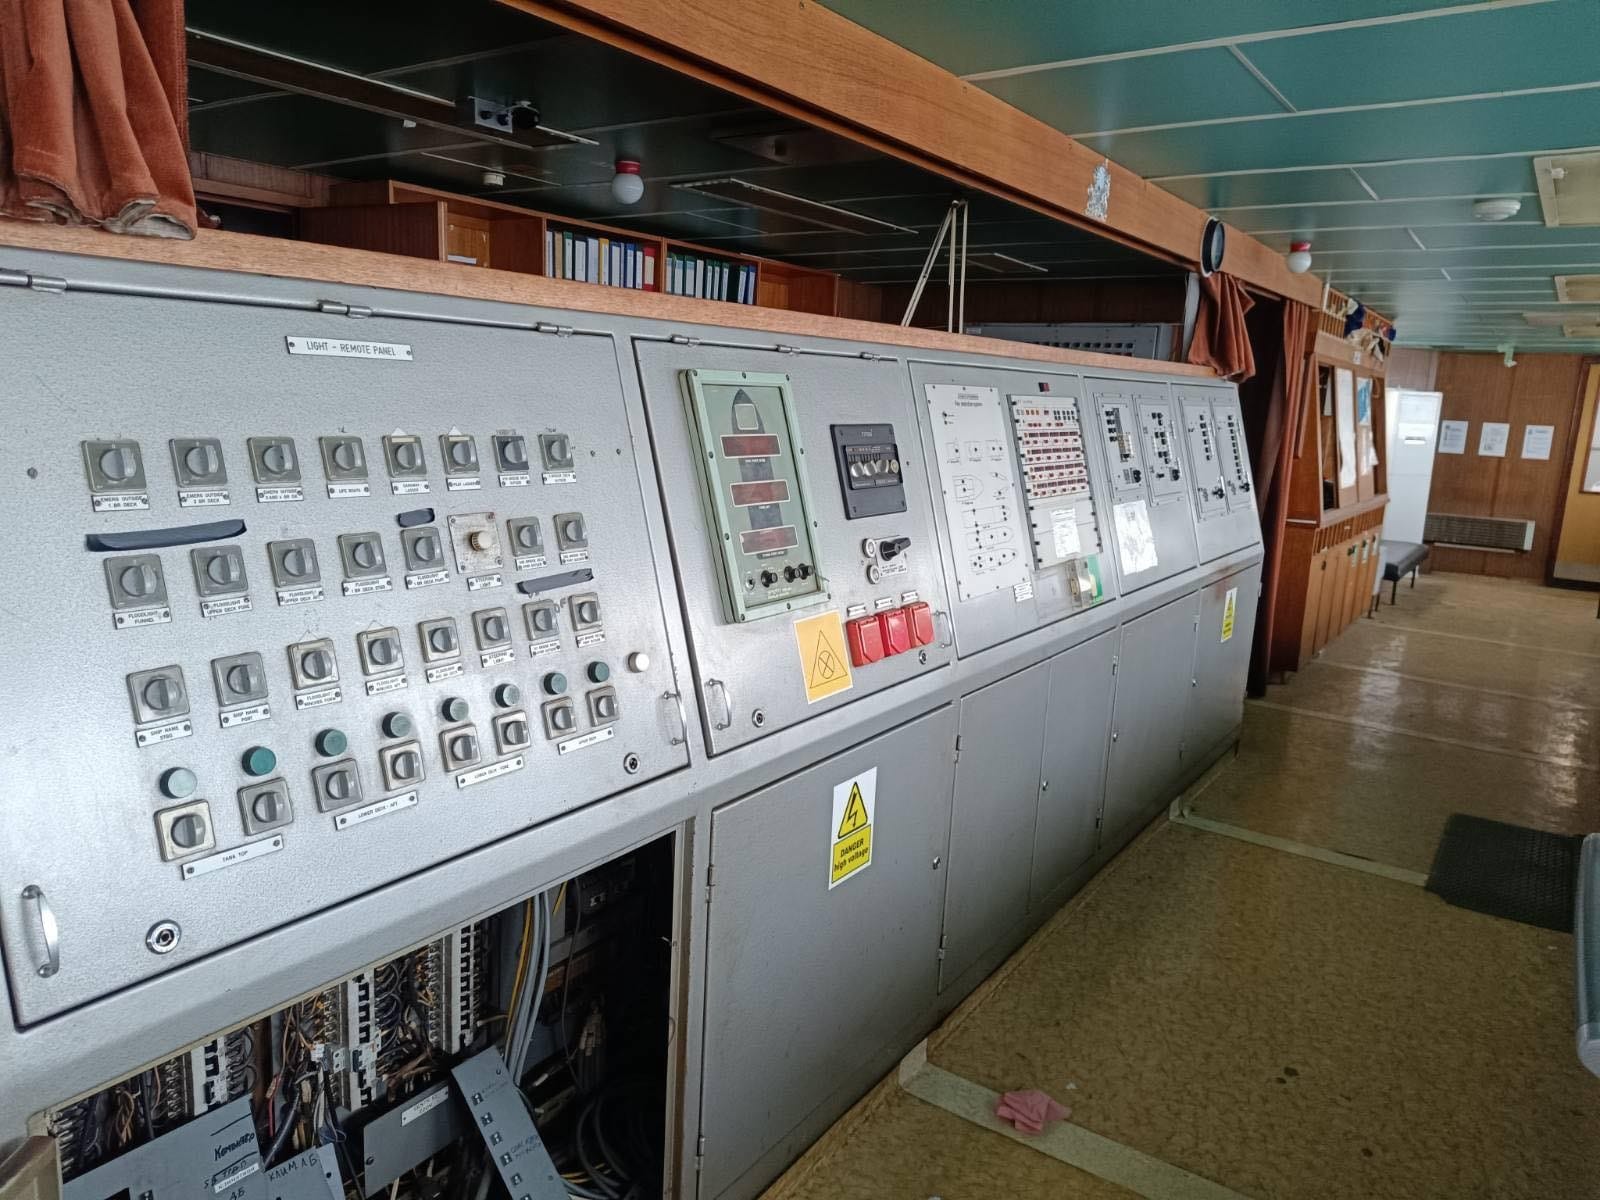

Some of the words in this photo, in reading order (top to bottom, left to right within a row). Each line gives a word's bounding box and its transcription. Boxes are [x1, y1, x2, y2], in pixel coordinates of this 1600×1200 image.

[306, 341, 328, 351] LIGHT
[339, 343, 371, 355] REMOTE
[373, 345, 397, 357] PANEL
[128, 611, 158, 619] FLOODLIGHT
[151, 729, 163, 737] SHIP
[358, 809, 374, 819] LOWER
[840, 838, 864, 858] DANGER
[238, 850, 249, 858] TOP
[833, 860, 847, 873] high
[847, 847, 869, 864] voltage
